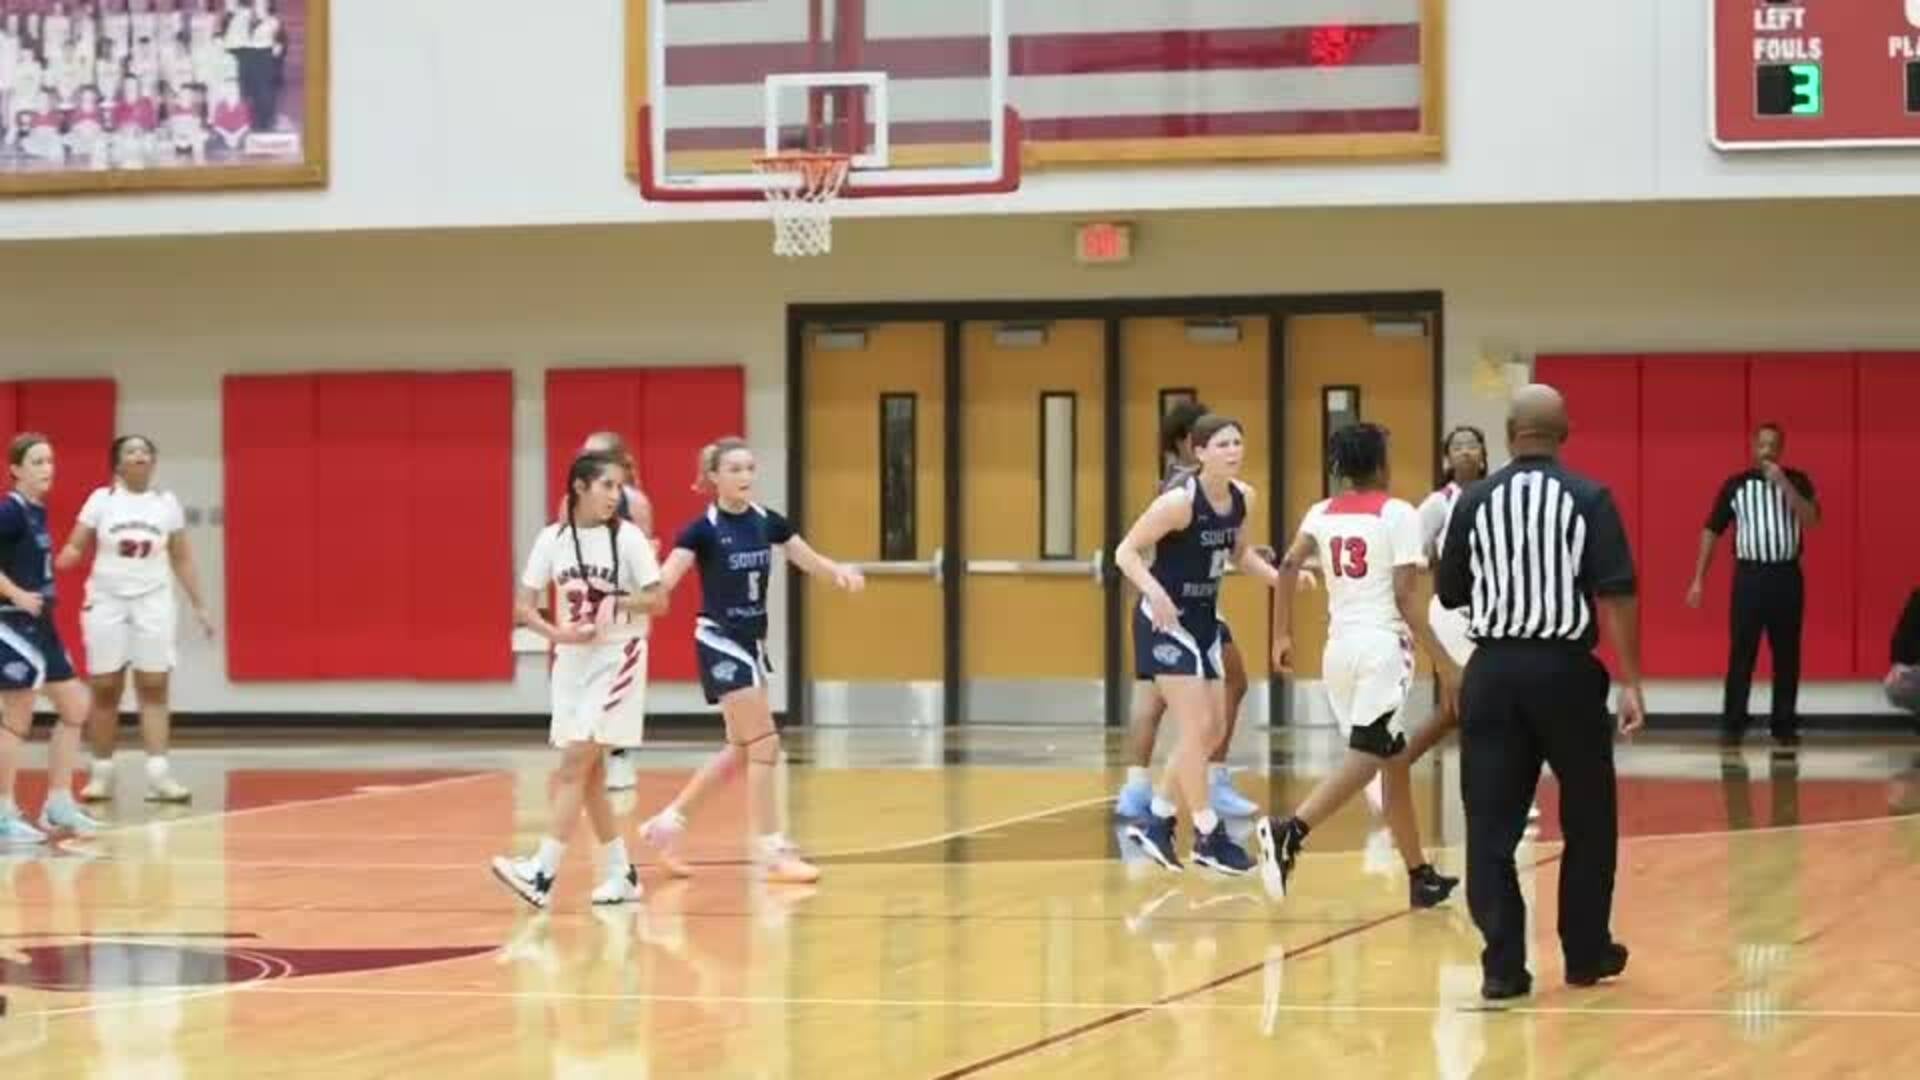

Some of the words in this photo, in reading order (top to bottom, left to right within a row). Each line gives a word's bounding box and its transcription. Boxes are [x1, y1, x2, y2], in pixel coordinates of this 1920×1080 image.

[1754, 7, 1805, 31] LEFT
[1753, 36, 1823, 61] FOULS
[1789, 64, 1820, 114] 3
[1329, 535, 1368, 579] 13
